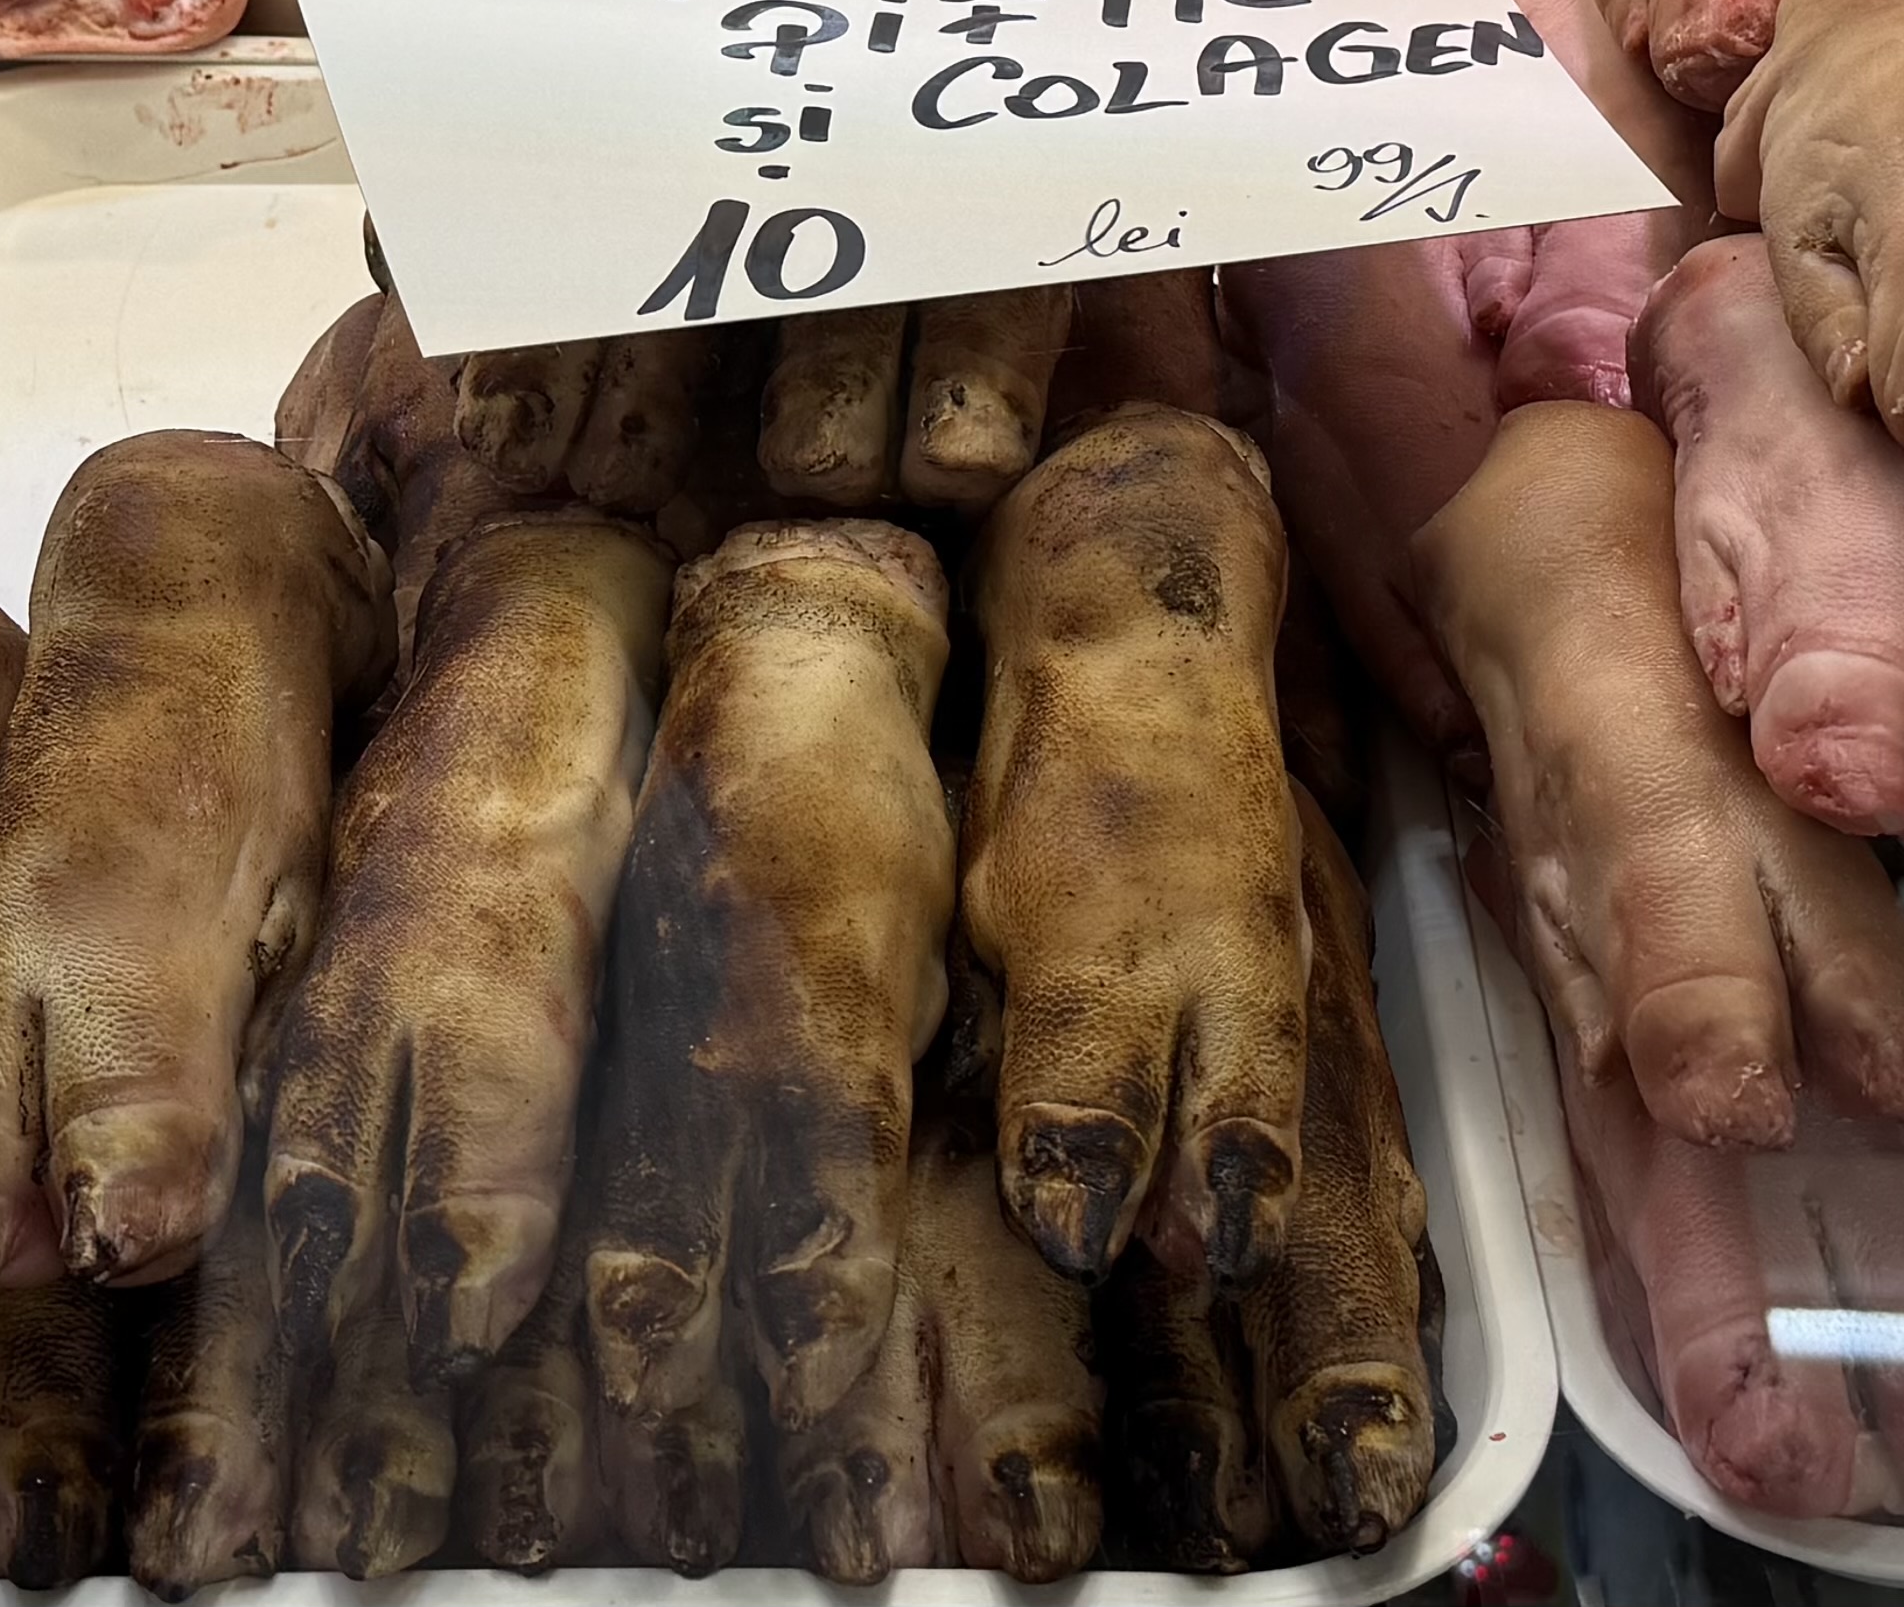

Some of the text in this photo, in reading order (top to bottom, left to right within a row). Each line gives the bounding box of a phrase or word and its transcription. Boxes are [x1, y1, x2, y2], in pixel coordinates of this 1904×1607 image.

[911, 10, 1546, 130] COLAGEN
[636, 197, 867, 322] 10
[1037, 198, 1189, 268] lei
